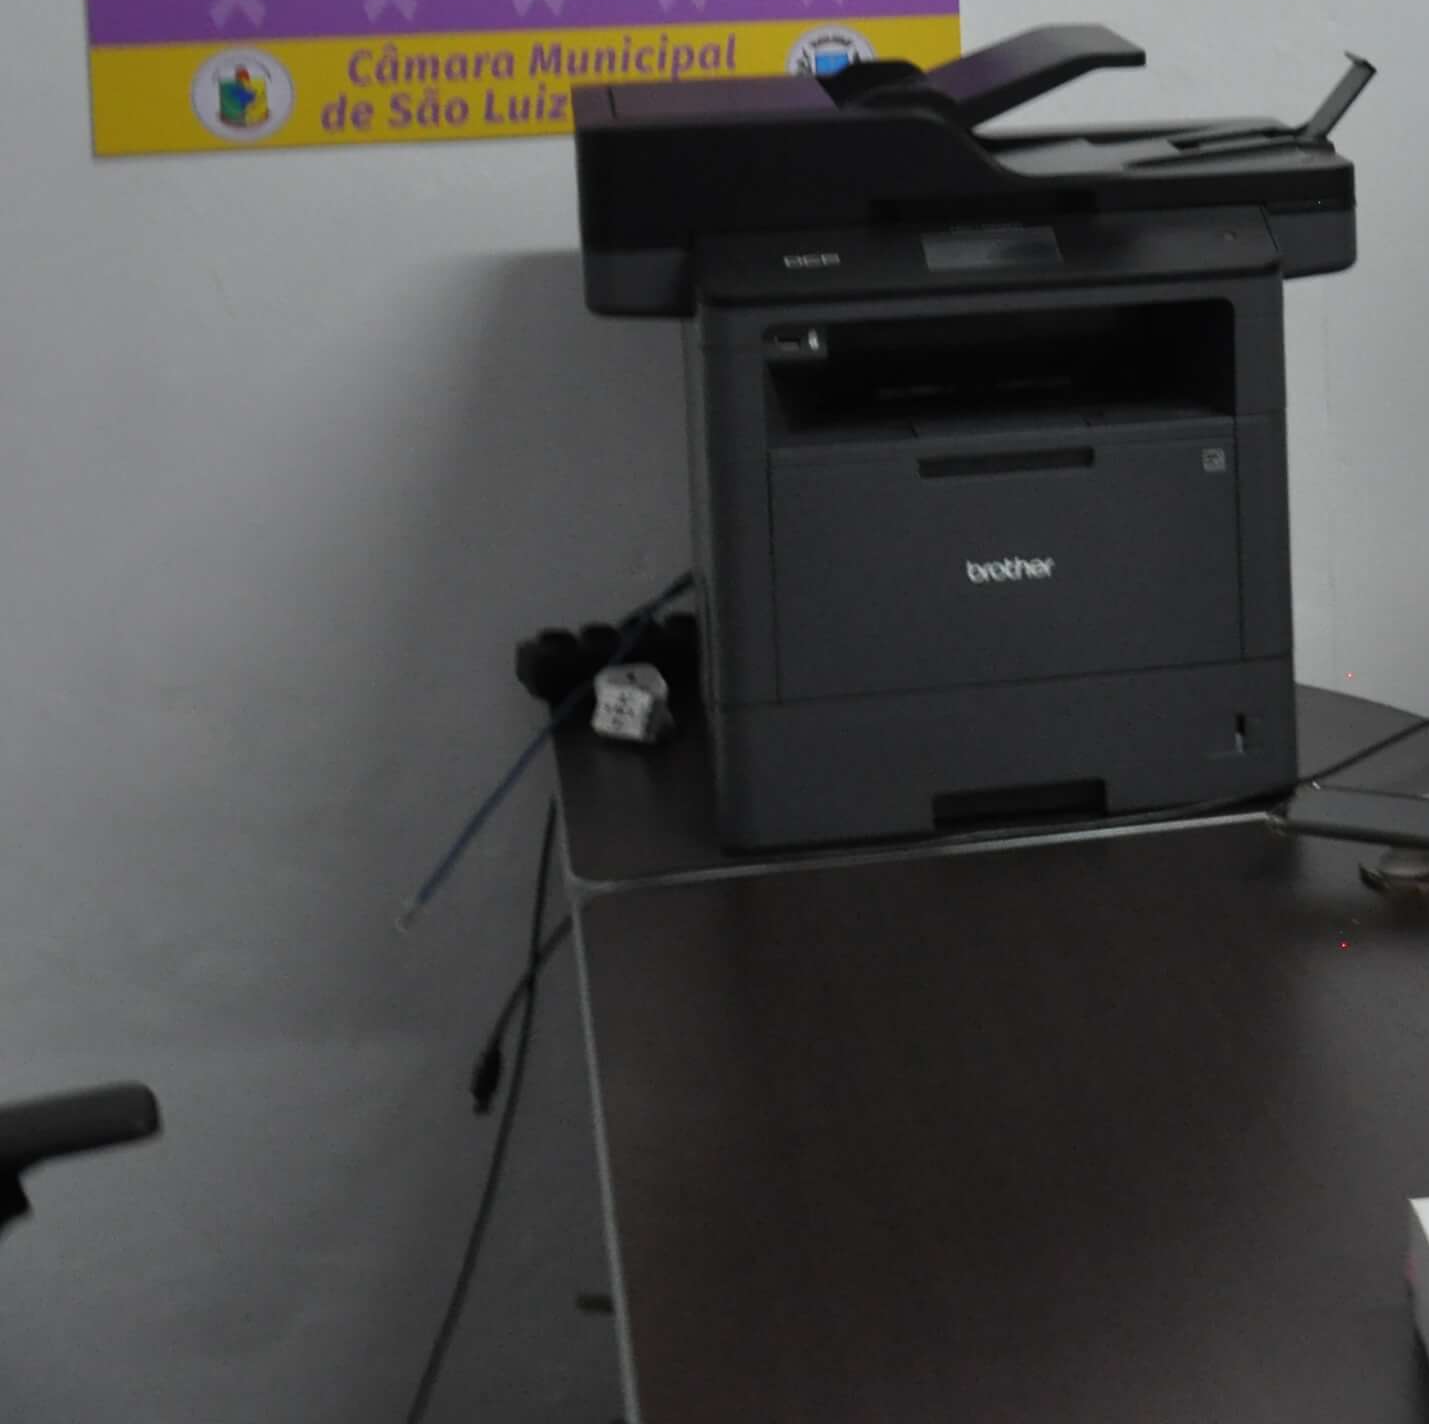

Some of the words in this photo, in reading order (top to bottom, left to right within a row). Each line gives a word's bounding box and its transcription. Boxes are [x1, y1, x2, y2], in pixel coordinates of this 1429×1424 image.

[348, 45, 515, 87] Câmara
[529, 32, 736, 81] Municipal
[321, 92, 374, 133] de
[389, 87, 470, 128] São
[484, 81, 567, 125] Luiz
[966, 555, 1055, 584] brother
